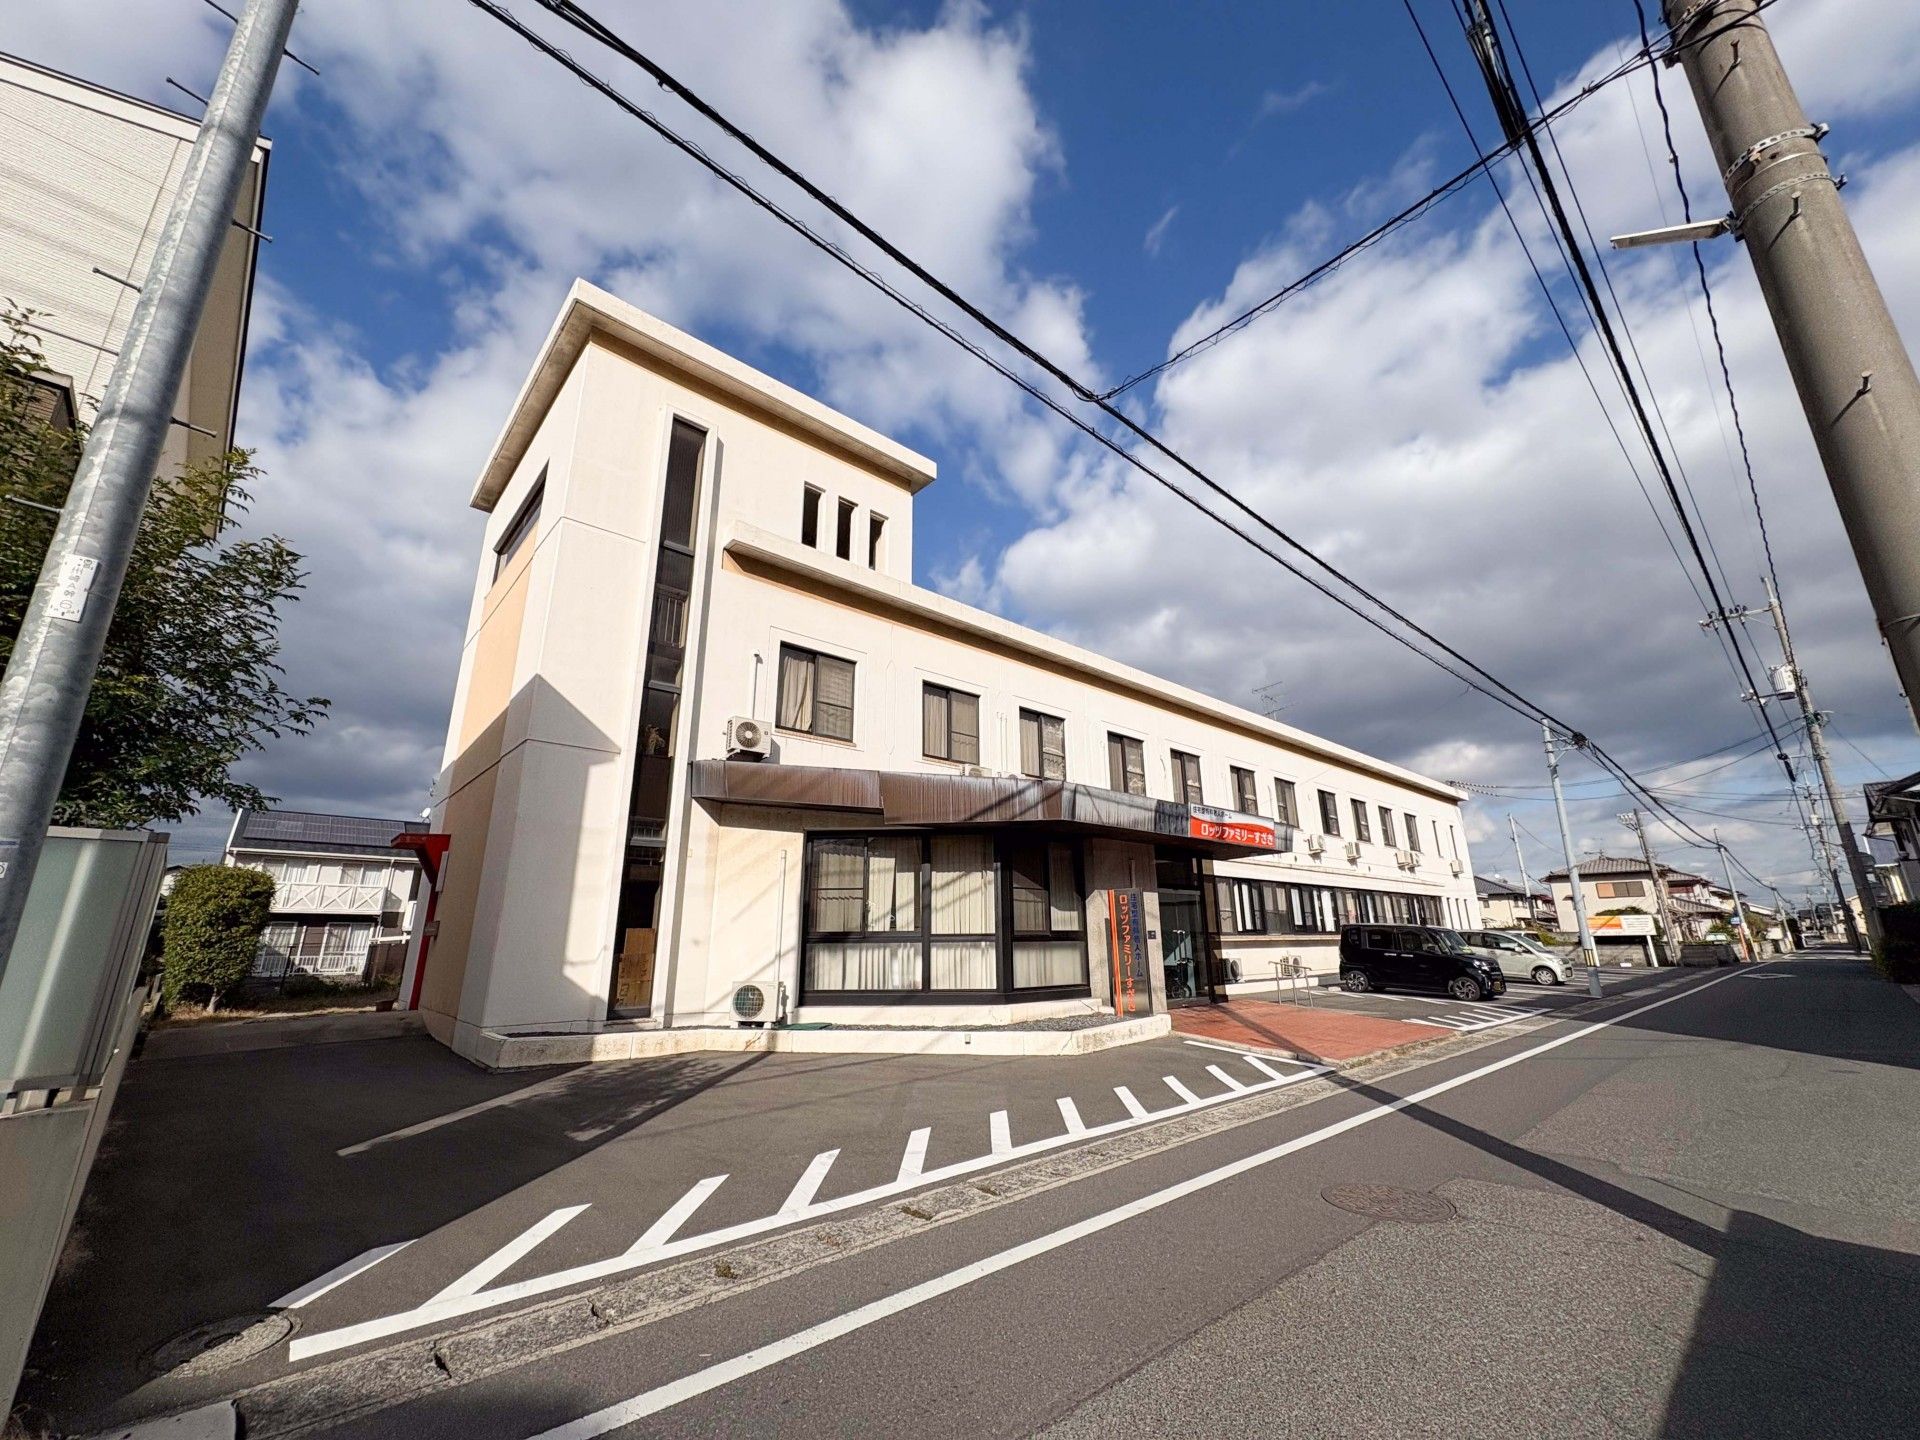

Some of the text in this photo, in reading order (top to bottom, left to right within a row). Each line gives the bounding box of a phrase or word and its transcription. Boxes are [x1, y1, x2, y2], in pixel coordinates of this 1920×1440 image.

[1201, 823, 1274, 845] ロッツファミリーすざき
[1119, 894, 1136, 1012] ロッツファミリーすざき
